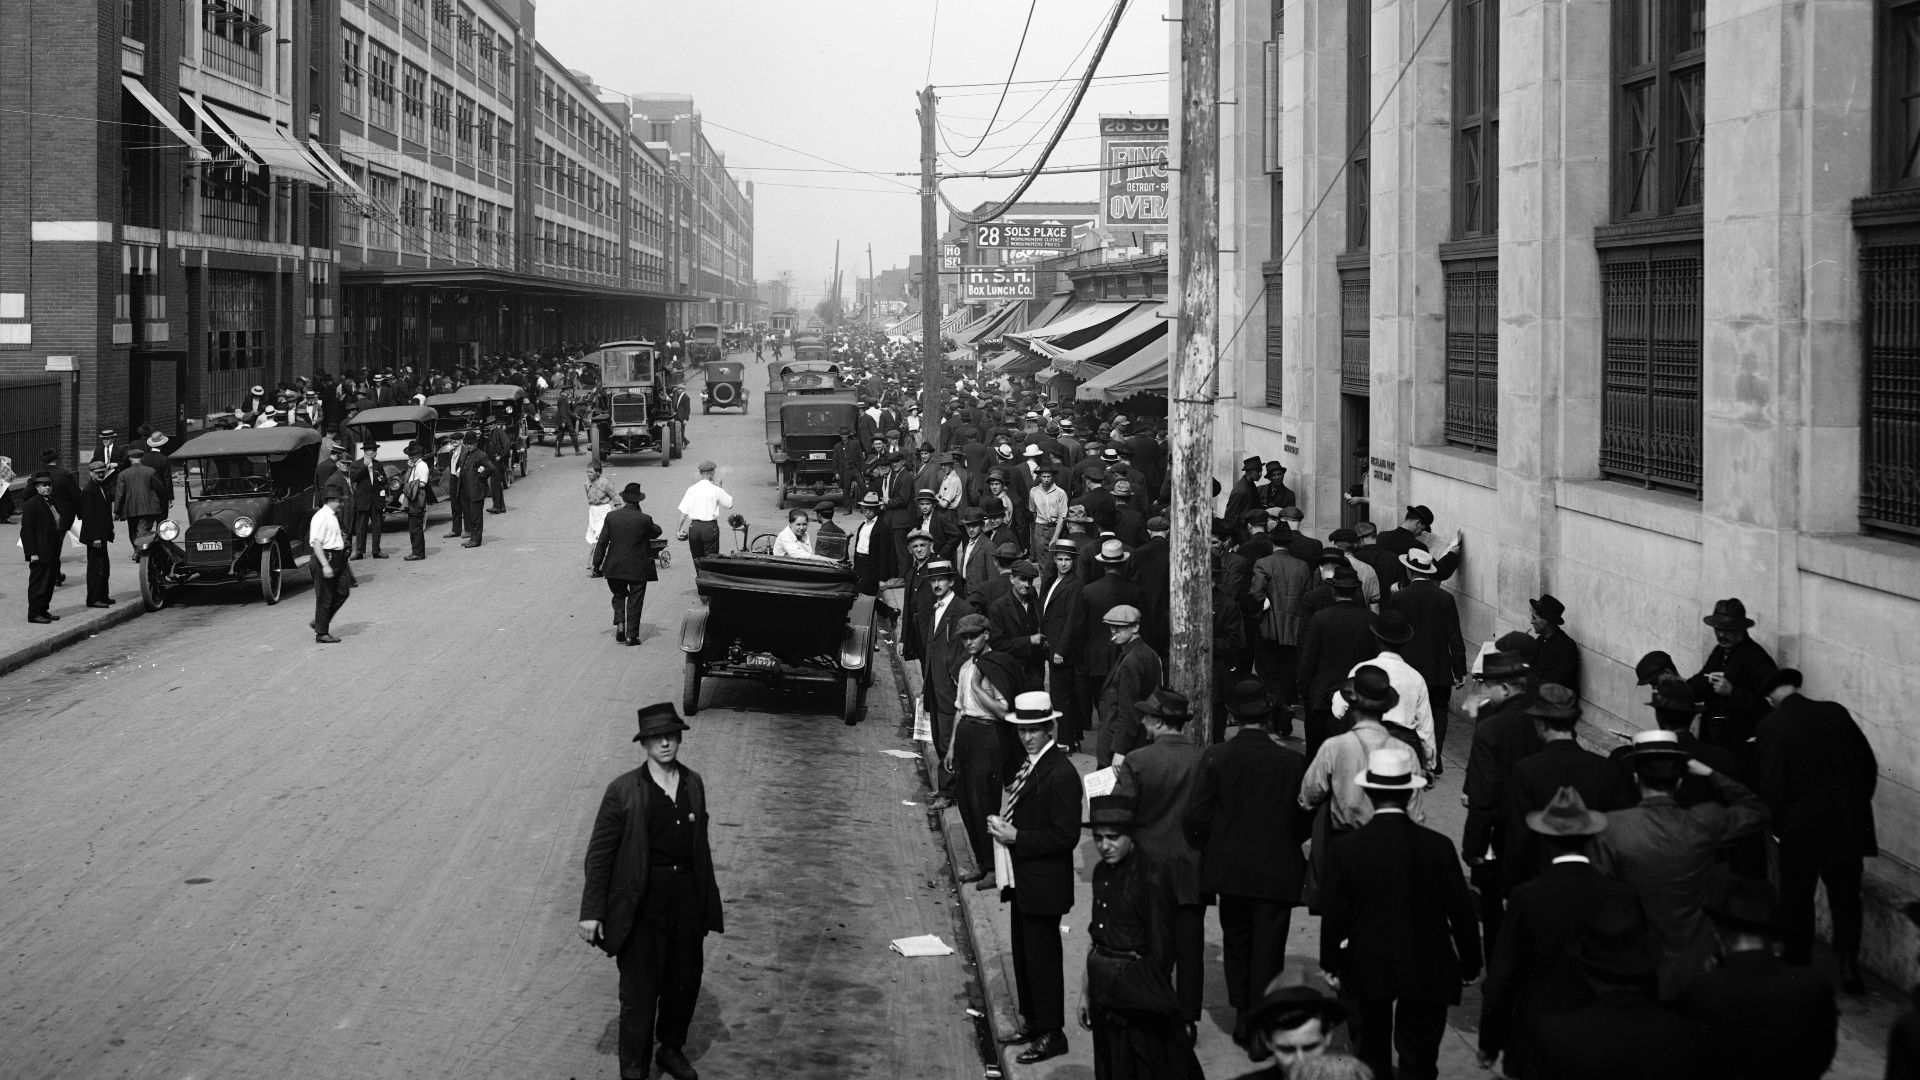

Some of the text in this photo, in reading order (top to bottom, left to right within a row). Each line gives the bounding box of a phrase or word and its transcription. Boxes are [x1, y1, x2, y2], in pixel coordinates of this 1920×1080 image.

[978, 226, 1000, 246] 28
[1003, 226, 1067, 238] SOL'S PLACE
